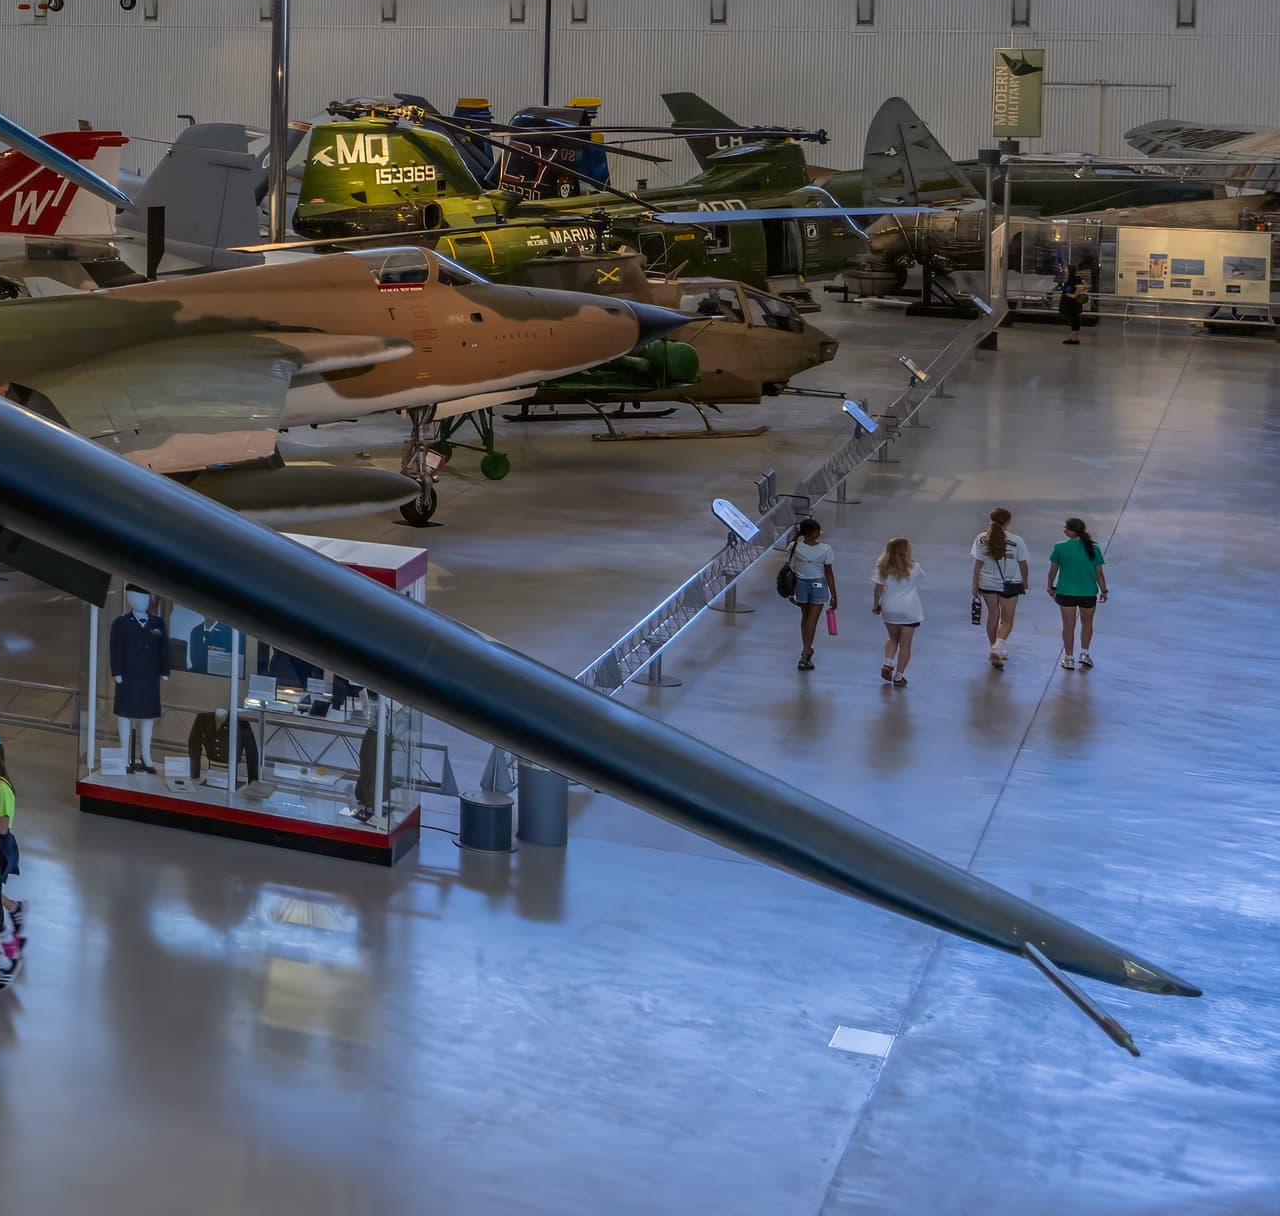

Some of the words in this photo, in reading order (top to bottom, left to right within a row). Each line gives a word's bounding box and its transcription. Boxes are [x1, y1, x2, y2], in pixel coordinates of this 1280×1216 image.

[994, 66, 1009, 126] MODERN
[1007, 72, 1020, 126] MILITARY
[335, 133, 390, 167] MQ
[375, 164, 437, 185] 153369
